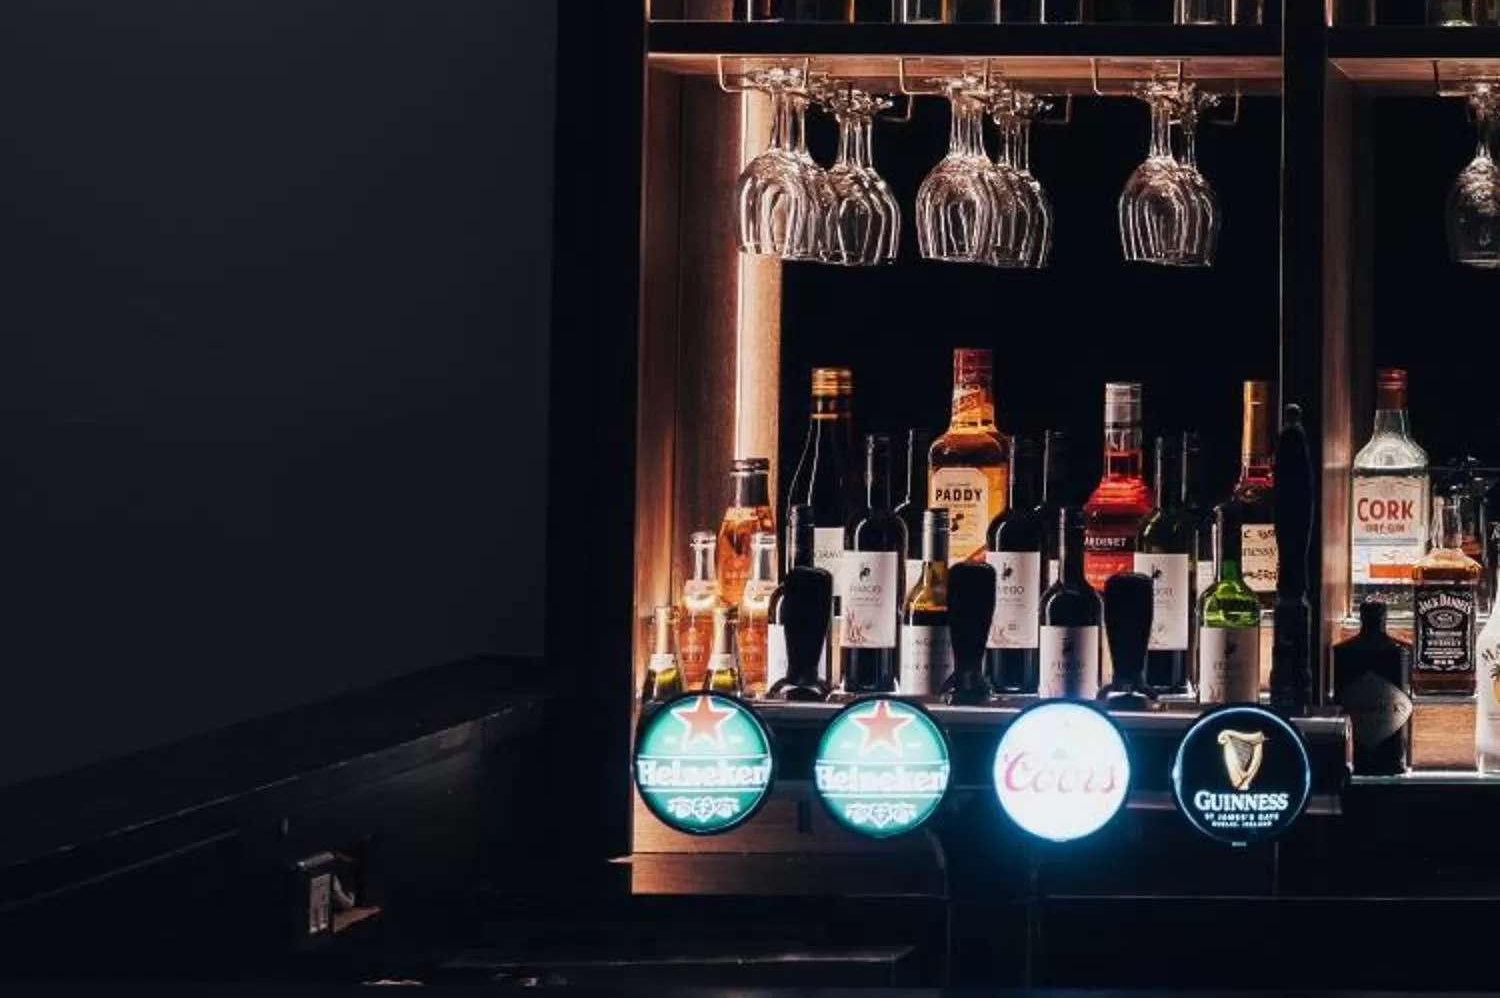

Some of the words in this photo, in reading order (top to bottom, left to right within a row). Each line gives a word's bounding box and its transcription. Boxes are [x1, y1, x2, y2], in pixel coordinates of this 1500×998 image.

[935, 488, 983, 501] PADDY
[1357, 497, 1414, 521] CORK
[1083, 536, 1128, 548] ARDINET
[637, 759, 771, 786] Heineken
[815, 763, 948, 792] Heineken
[1003, 751, 1119, 793] Coors
[1194, 790, 1289, 812] GUINNESS
